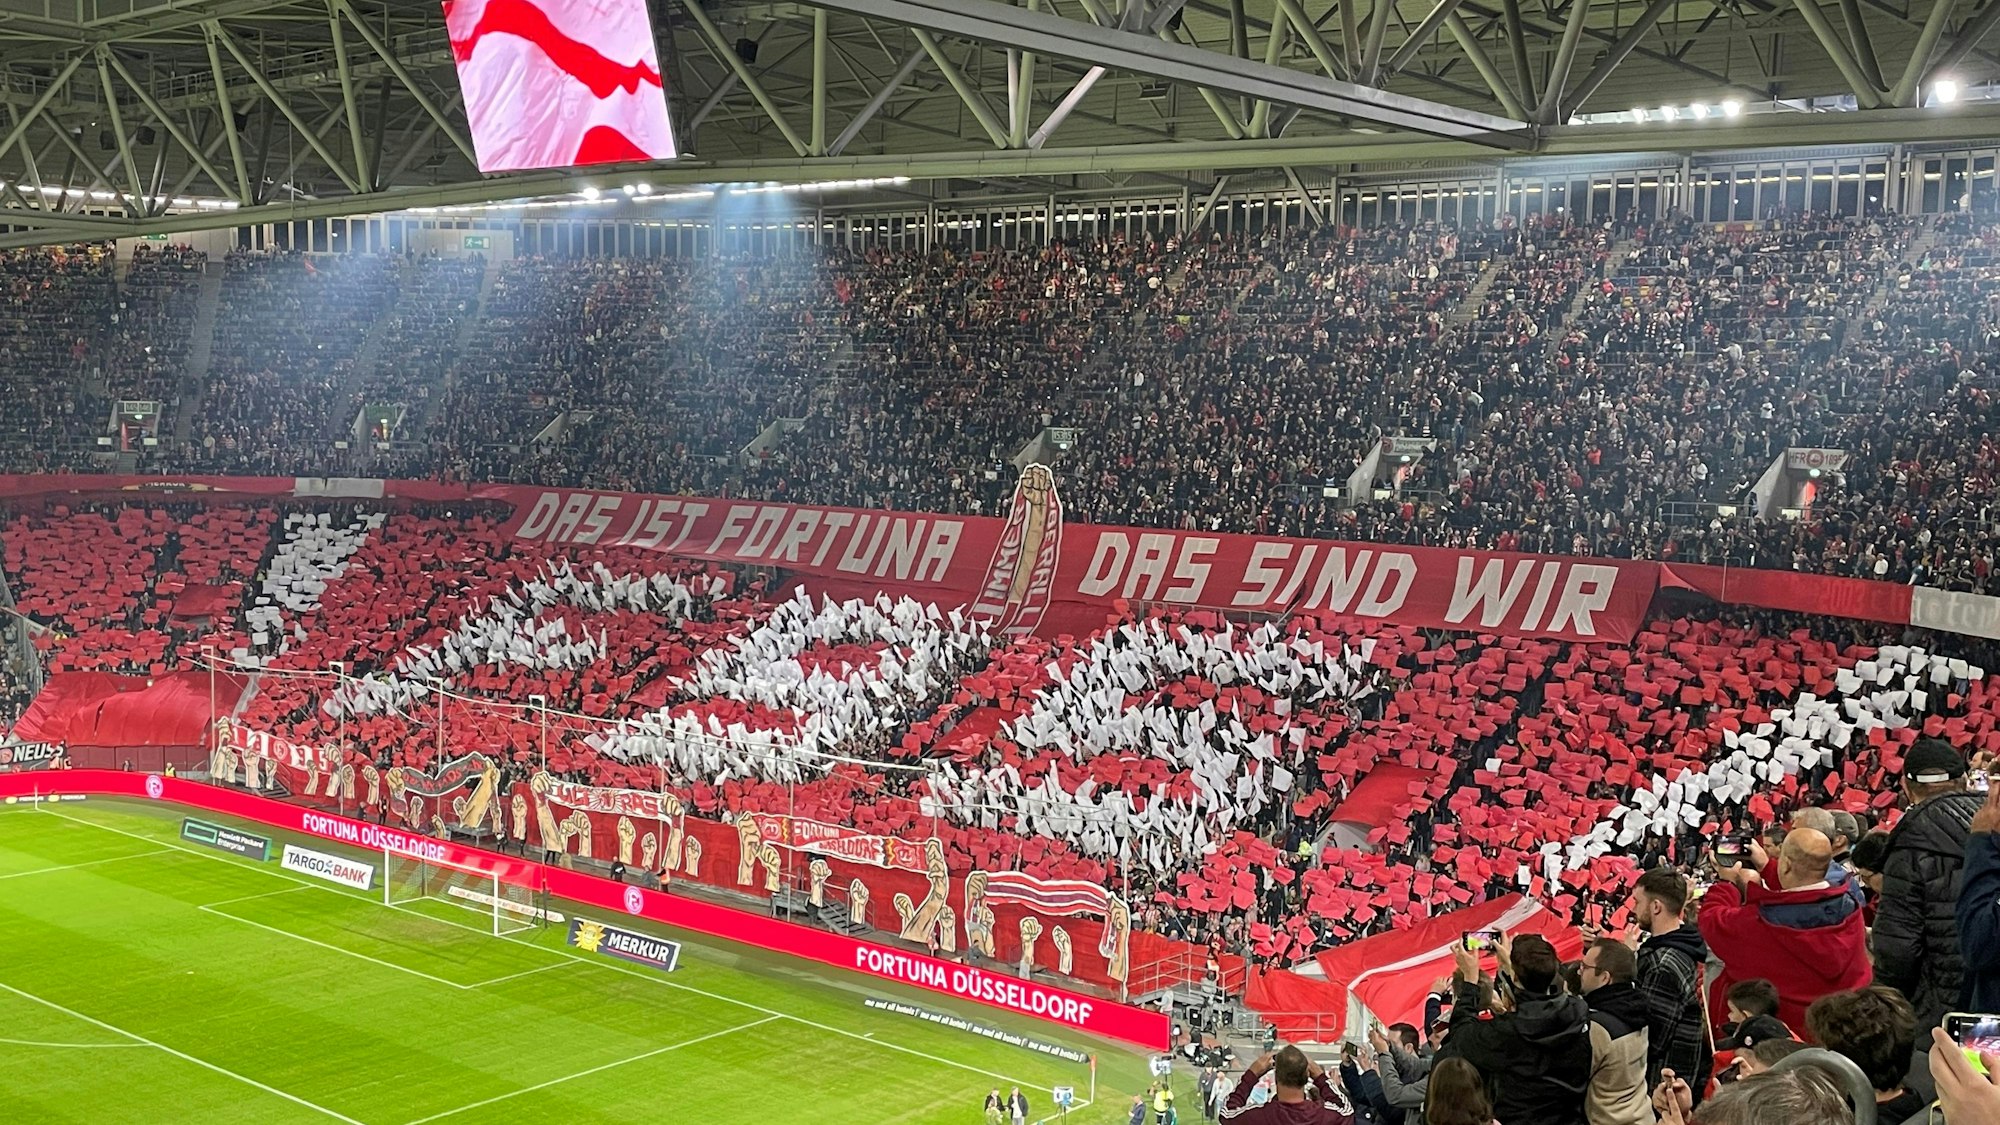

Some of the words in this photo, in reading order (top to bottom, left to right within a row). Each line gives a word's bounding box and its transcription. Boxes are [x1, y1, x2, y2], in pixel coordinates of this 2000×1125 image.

[515, 492, 622, 545] DAS
[614, 499, 709, 550] IST
[705, 505, 964, 582] FORTUNA
[984, 502, 1024, 600] IMMER
[1077, 531, 1221, 603] DAS
[1231, 541, 1418, 618] SIND
[1444, 556, 1619, 636] WIR
[303, 813, 359, 842] FORTUNA
[361, 826, 445, 860] DÜSSELDORF
[607, 932, 669, 962] MERKUR
[856, 947, 948, 988] FORTUNA
[953, 969, 1093, 1024] DÜSSELDORF
